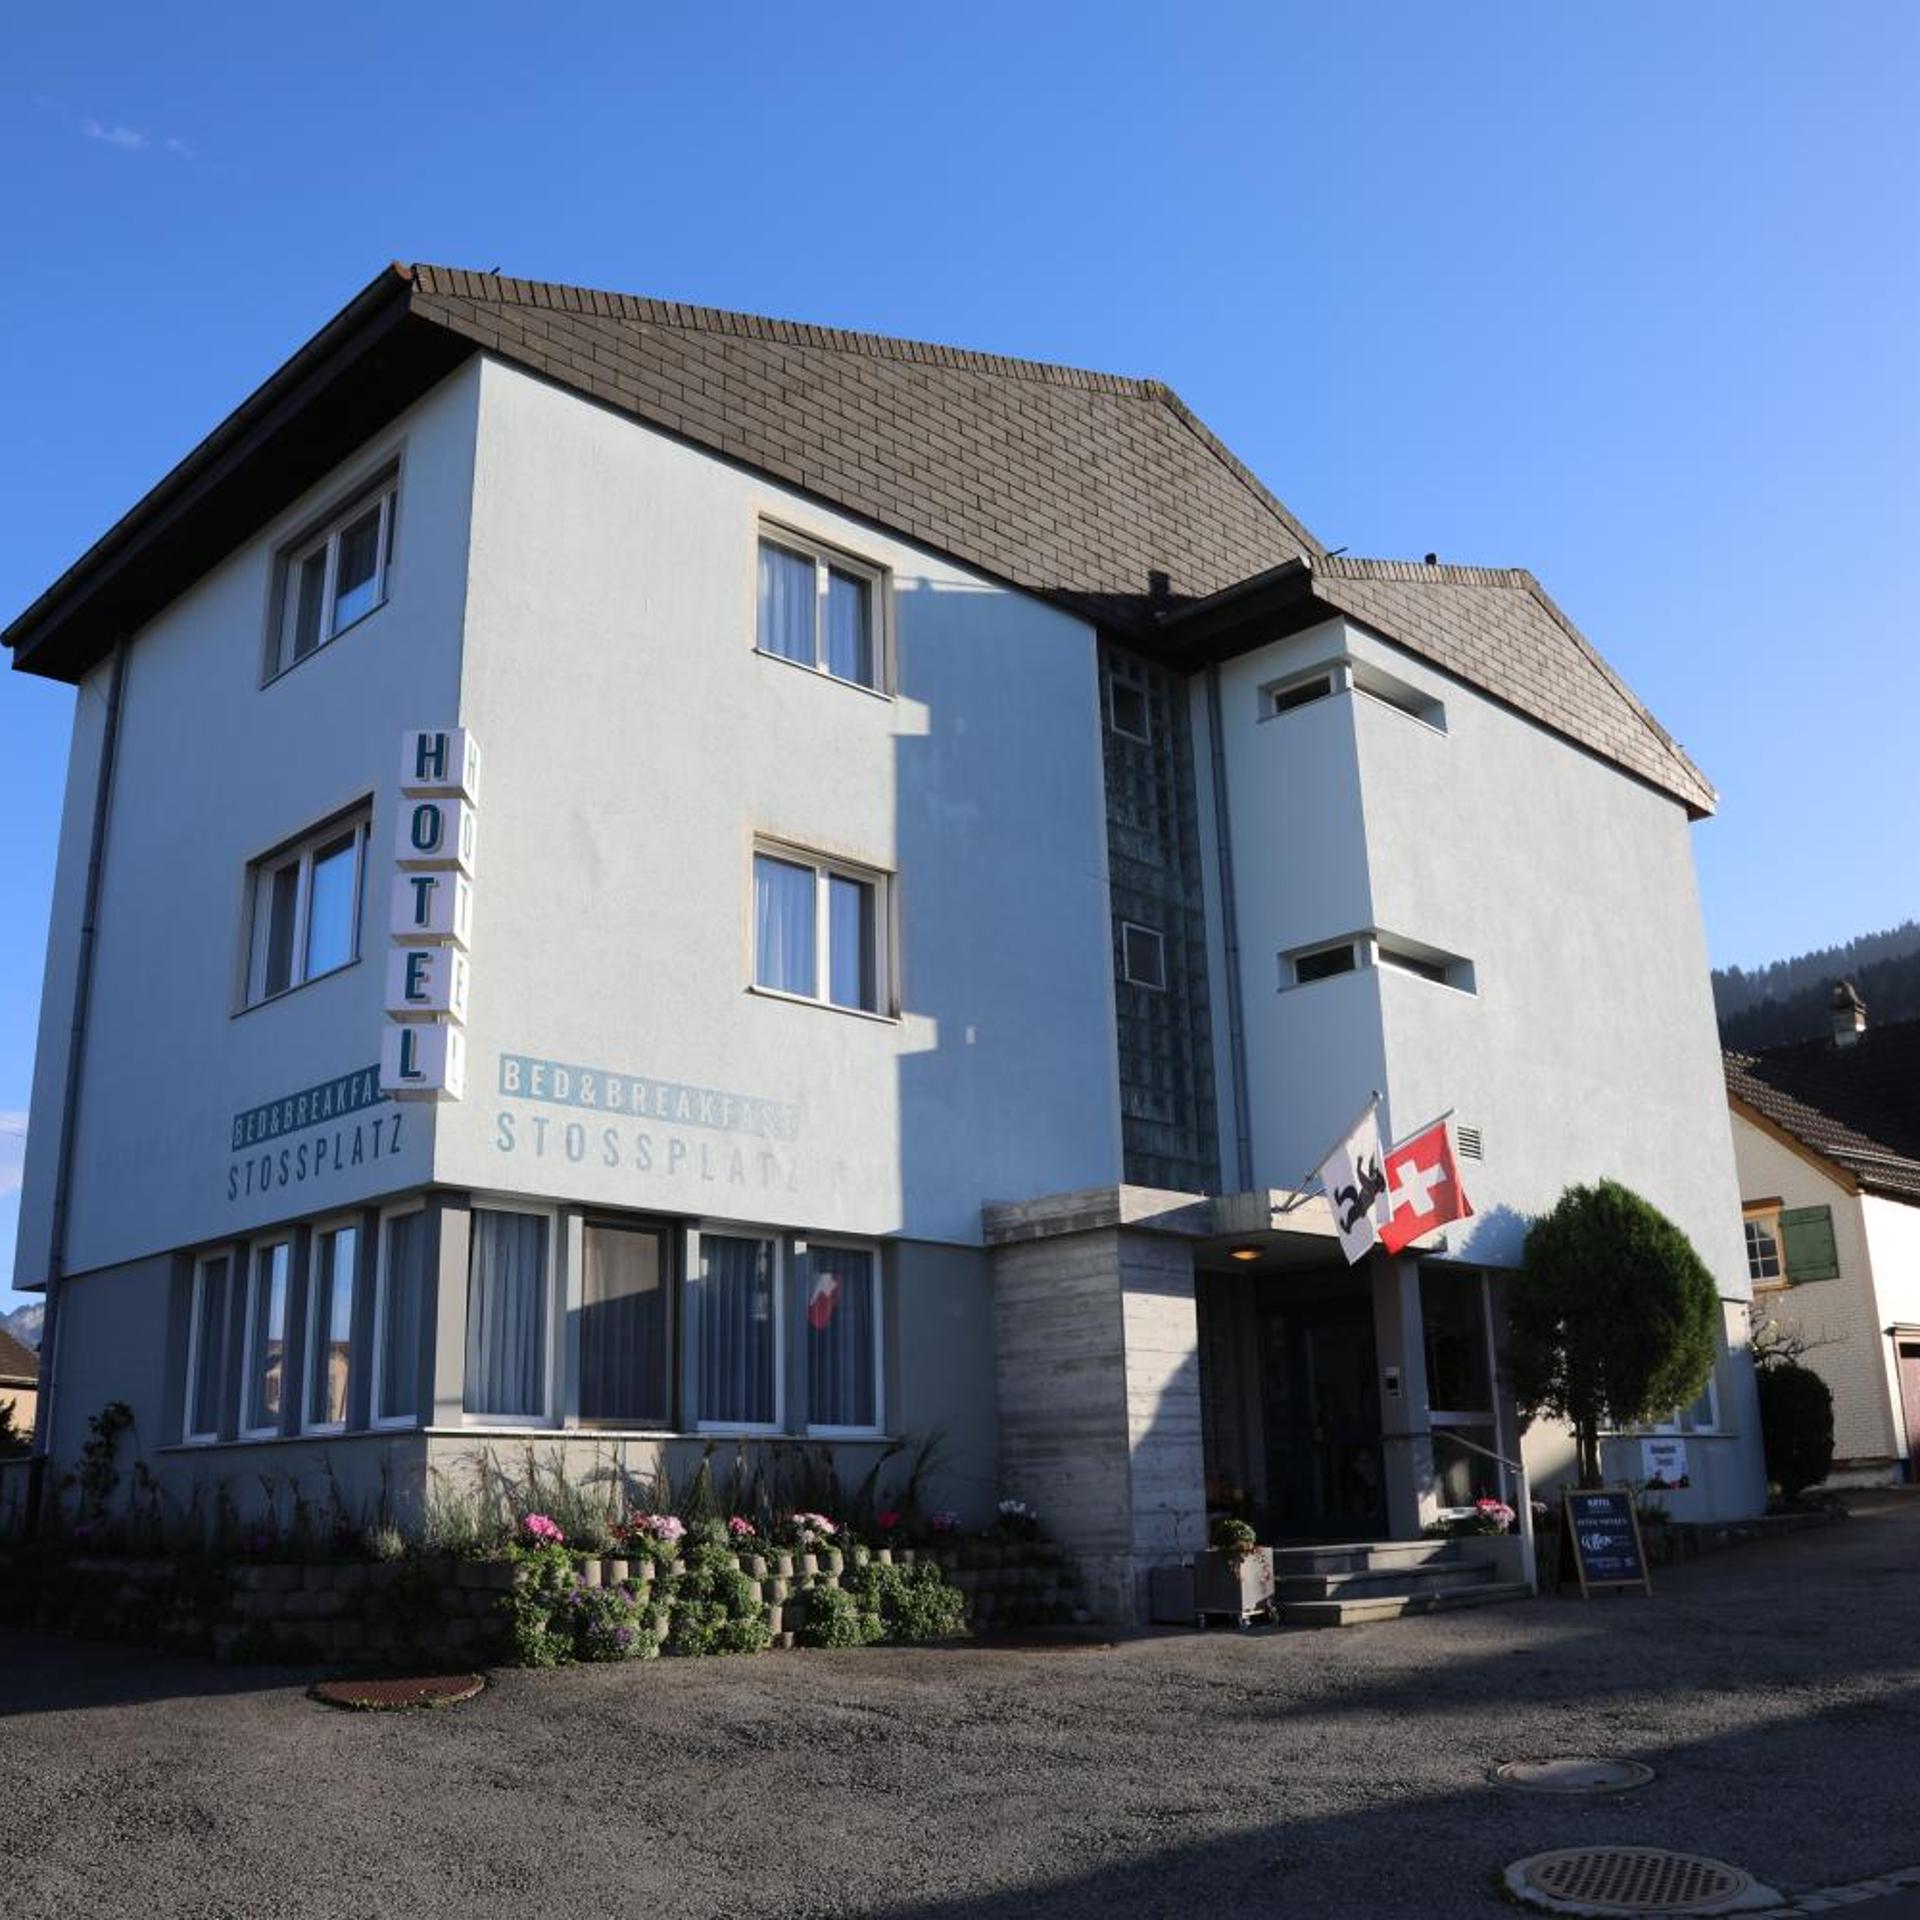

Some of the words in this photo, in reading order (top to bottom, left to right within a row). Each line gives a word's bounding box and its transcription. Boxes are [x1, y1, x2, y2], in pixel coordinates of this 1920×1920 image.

[399, 732, 448, 1080] HOTEL
[234, 1071, 385, 1147] BED&BREAKFA
[504, 1060, 798, 1134] BED&BREAKFAST
[228, 1114, 402, 1200] STOSSPLATZ
[498, 1112, 799, 1192] STOSSPLATZ
